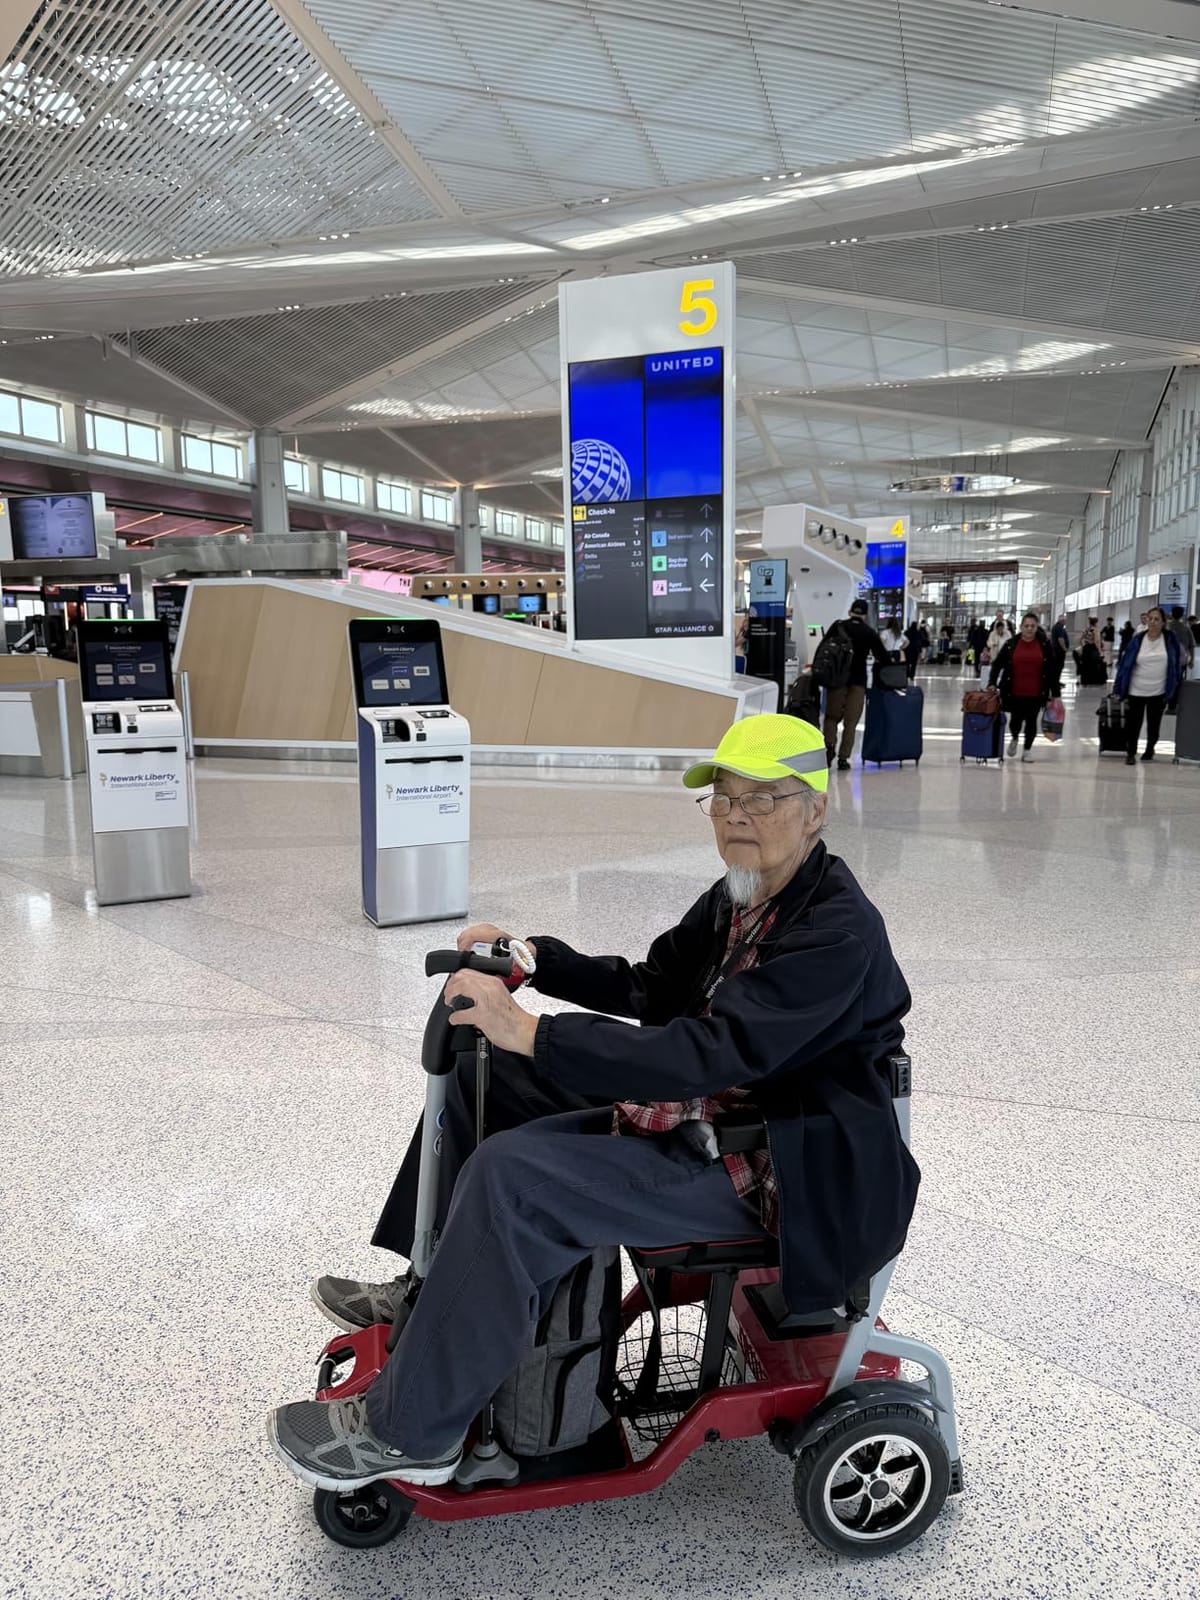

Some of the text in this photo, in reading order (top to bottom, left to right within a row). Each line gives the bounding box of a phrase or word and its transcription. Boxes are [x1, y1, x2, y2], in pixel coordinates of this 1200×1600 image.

[678, 278, 718, 336] 5
[651, 356, 713, 372] UNITED
[588, 507, 616, 516] Check-in
[890, 519, 905, 538] 4
[673, 625, 706, 633] ALLIANCE
[110, 773, 176, 782] Newark Liberty
[396, 784, 460, 794] Newark Liberty
[396, 793, 431, 801] International
[745, 921, 763, 944] verizon
